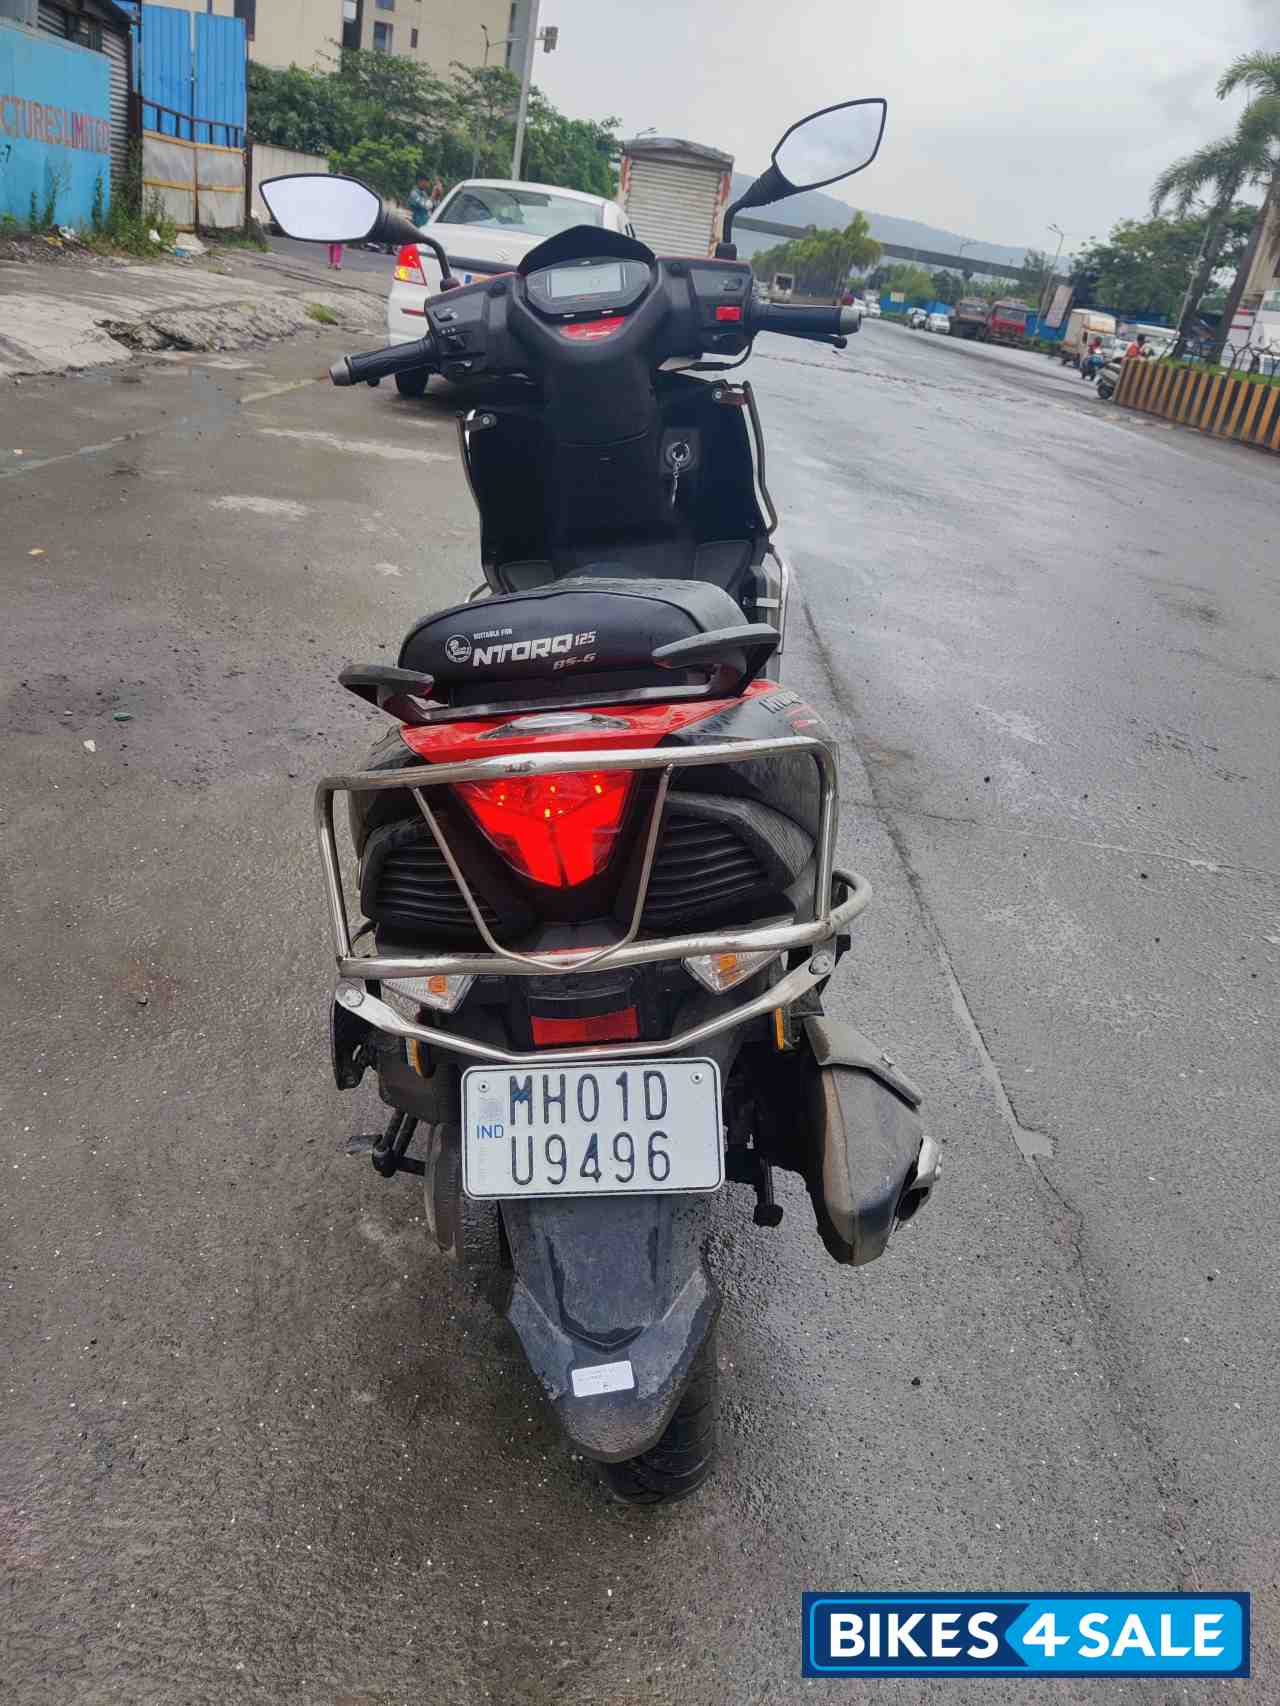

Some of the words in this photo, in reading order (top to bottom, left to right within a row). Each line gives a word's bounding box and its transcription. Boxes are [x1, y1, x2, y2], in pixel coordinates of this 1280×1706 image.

[472, 633, 573, 667] NTORQ
[575, 631, 597, 646] 125
[553, 652, 597, 671] BS-6
[509, 1070, 668, 1126] MH01D
[476, 1124, 504, 1139] IND
[511, 1130, 671, 1186] U9496
